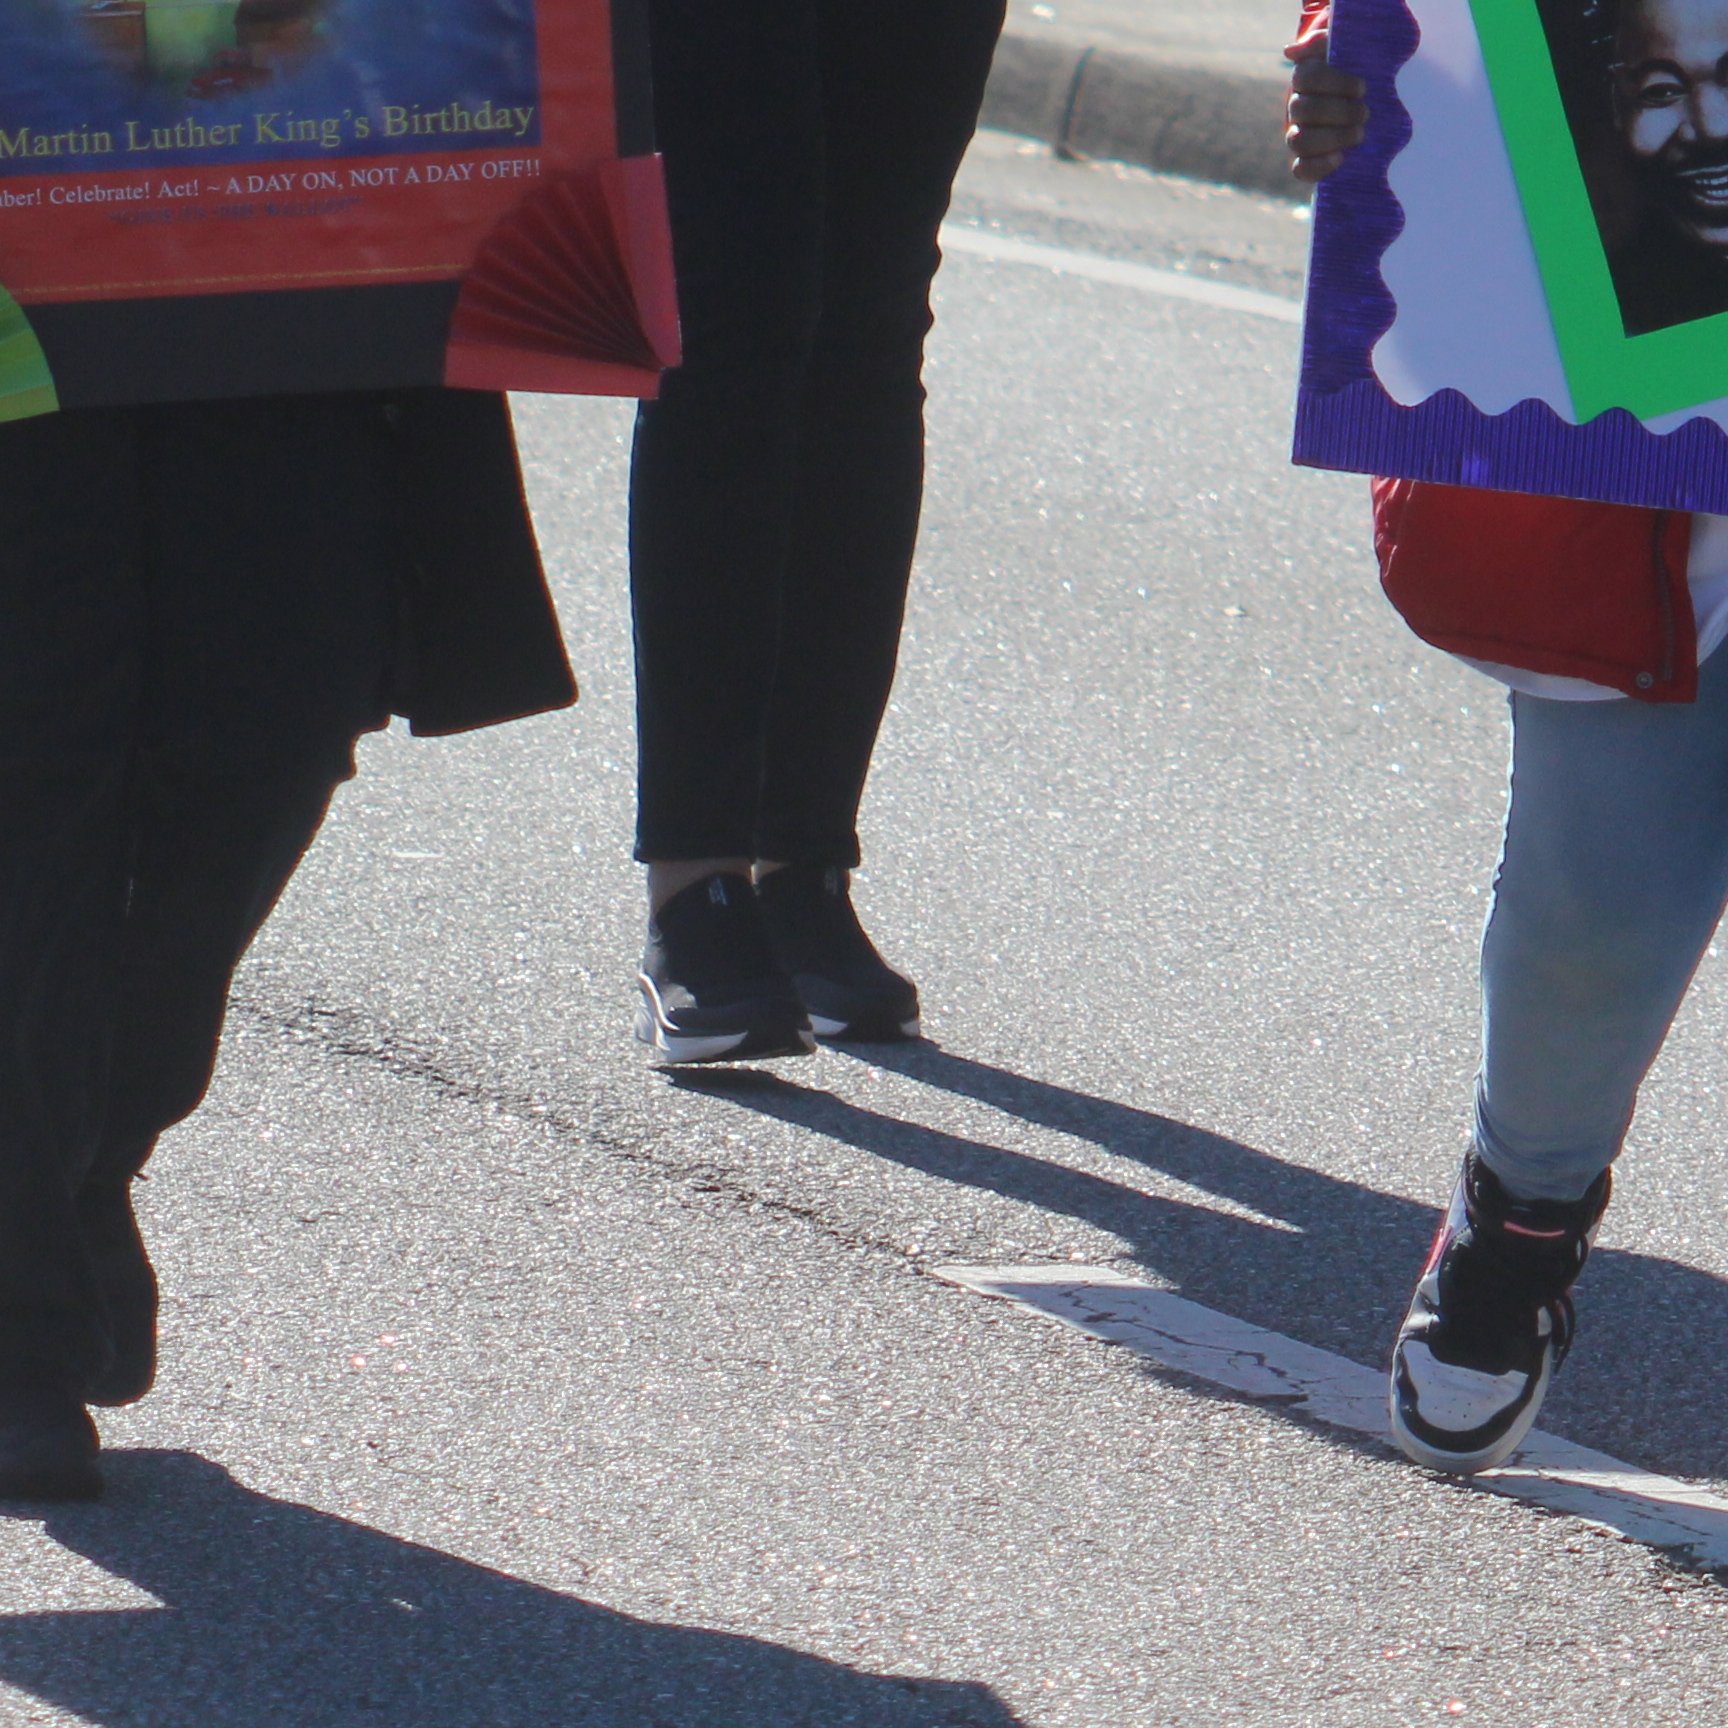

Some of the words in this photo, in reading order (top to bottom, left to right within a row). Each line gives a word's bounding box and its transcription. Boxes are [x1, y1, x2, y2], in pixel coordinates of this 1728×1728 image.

[124, 116, 243, 153] Luther
[254, 108, 370, 148] King’s
[381, 99, 535, 137] Birthday
[48, 182, 150, 205] Celebrate!
[156, 178, 199, 198] Act!
[224, 176, 242, 194] A
[247, 173, 297, 193] DAY
[301, 170, 344, 191] ON,
[350, 167, 400, 188] NOT
[403, 166, 422, 185] A
[426, 162, 476, 184] DAY
[480, 158, 541, 180] OFF!!
